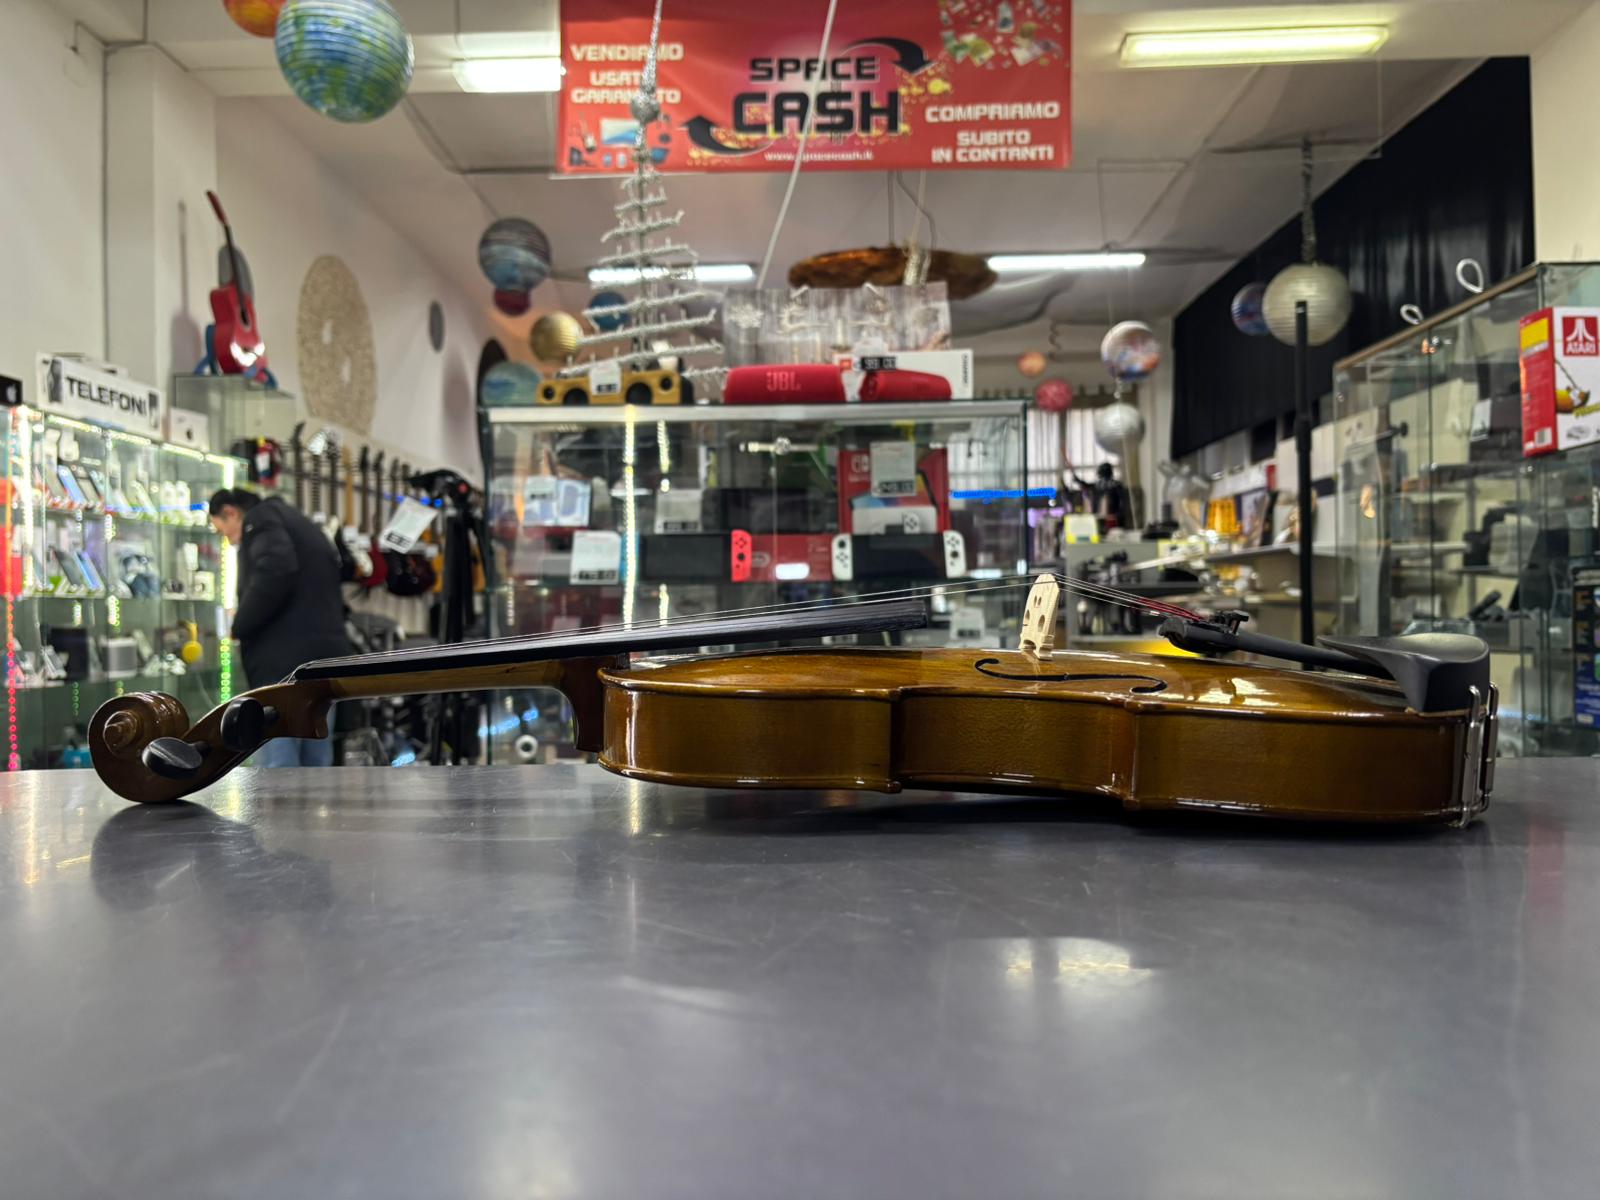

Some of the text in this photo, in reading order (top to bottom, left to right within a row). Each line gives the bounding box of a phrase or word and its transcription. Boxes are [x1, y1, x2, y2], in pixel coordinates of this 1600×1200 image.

[590, 70, 645, 86] USAT
[750, 56, 877, 81] SPACE
[734, 90, 900, 133] CASH
[925, 101, 1060, 122] COMPRIAMO
[956, 129, 1031, 146] SUBITO
[931, 144, 1054, 163] IN CONTANTI
[1566, 343, 1596, 355] ATARI
[766, 371, 801, 391] JBL
[66, 376, 147, 416] TELEFONI
